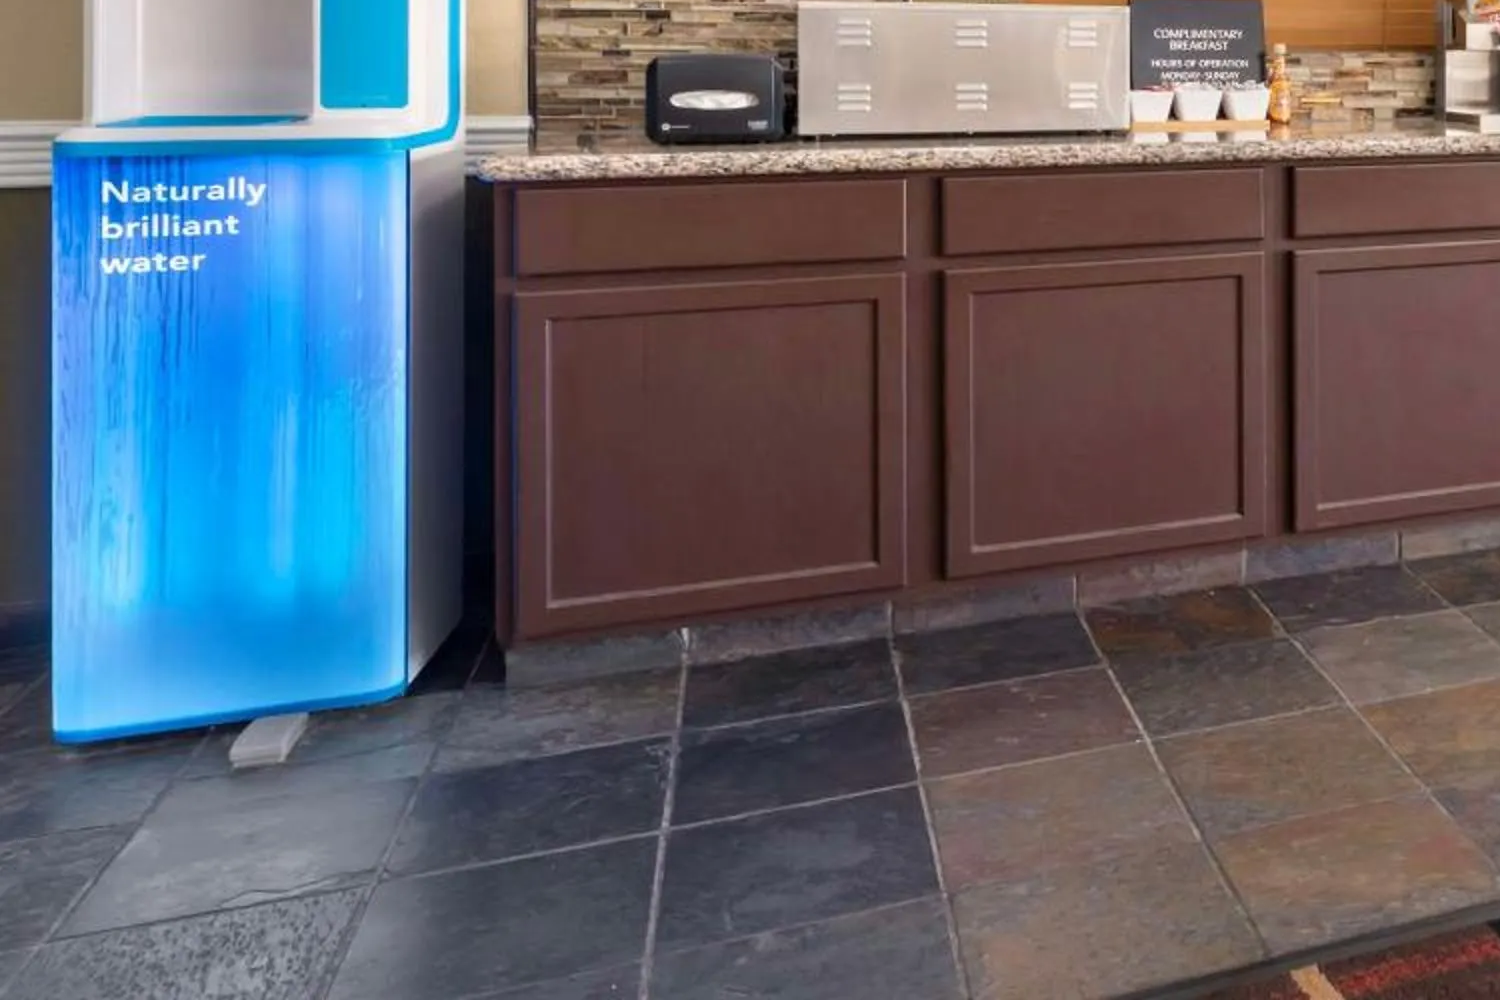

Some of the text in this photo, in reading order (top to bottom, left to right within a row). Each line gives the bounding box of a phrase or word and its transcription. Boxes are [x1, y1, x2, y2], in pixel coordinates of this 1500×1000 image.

[1169, 39, 1229, 51] BREAKFAST
[102, 176, 267, 207] Naturally
[102, 213, 240, 239] brilliant
[101, 252, 206, 275] water
